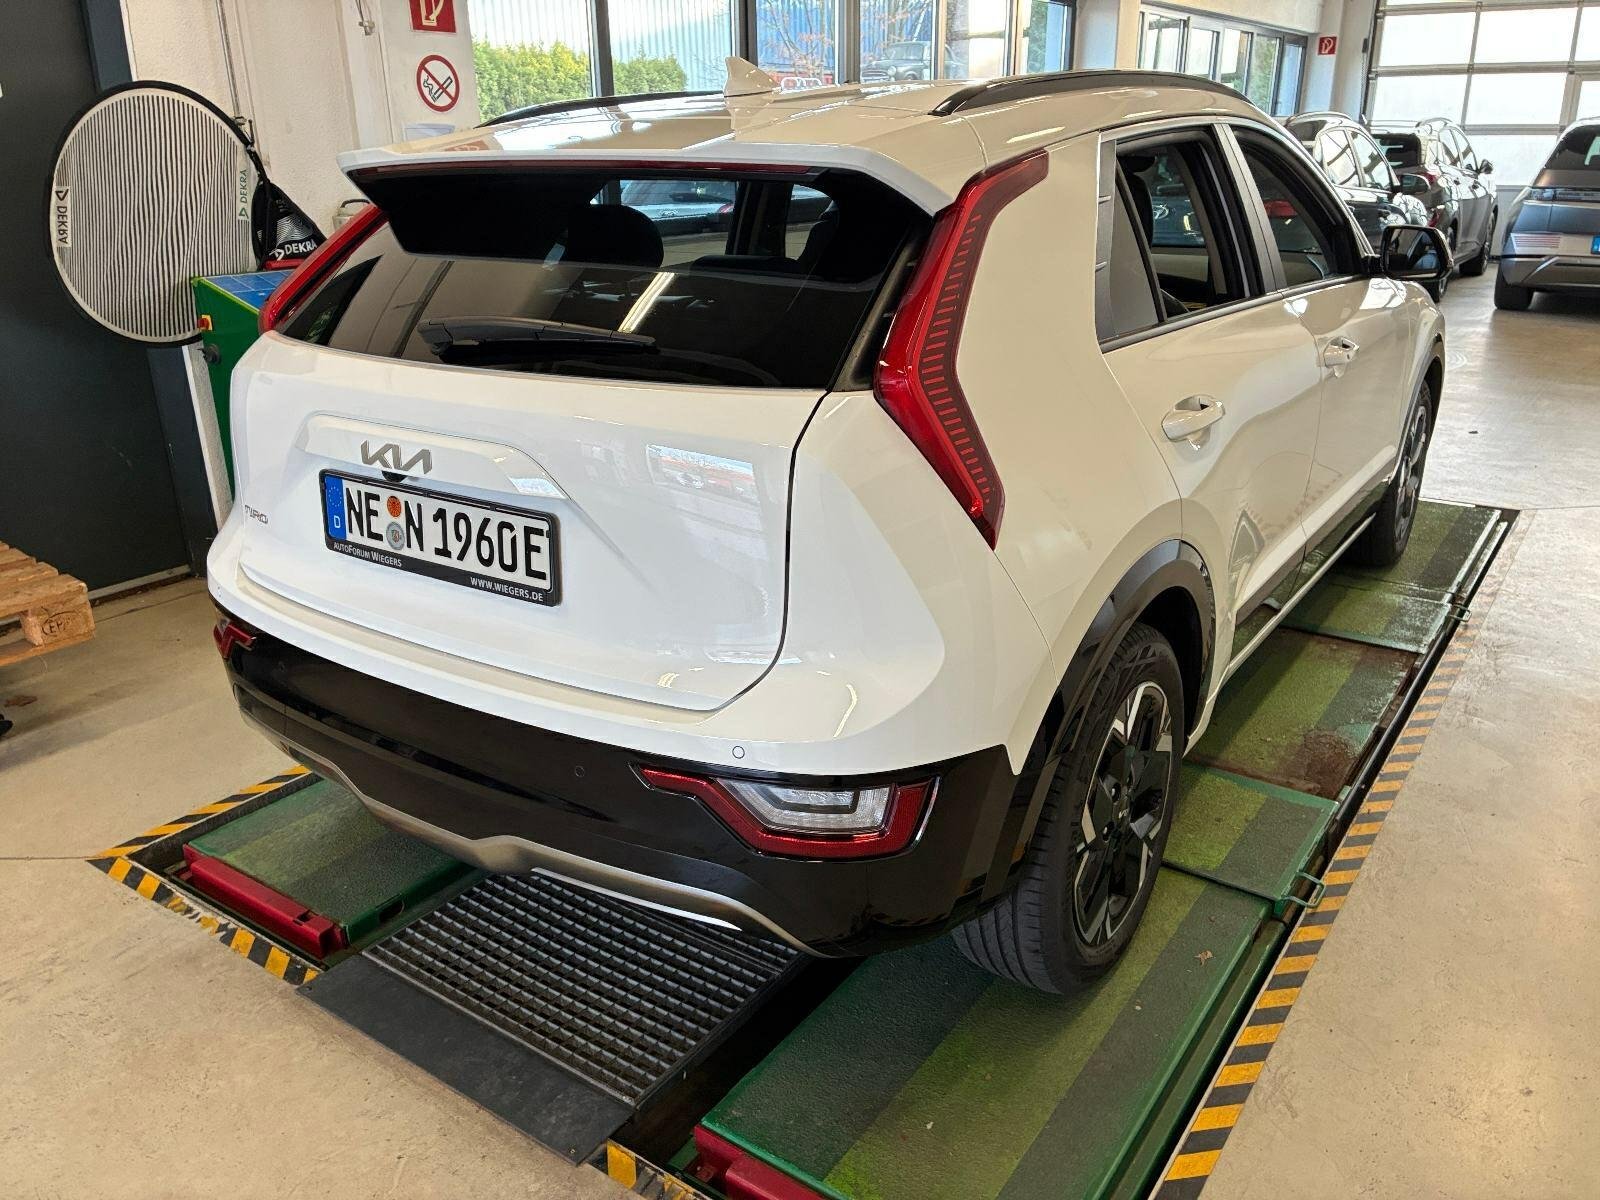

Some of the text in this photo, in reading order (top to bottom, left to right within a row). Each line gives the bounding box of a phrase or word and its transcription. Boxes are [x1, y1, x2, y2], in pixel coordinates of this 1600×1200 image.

[239, 169, 248, 204] DEKRA
[284, 239, 318, 255] DEKRA
[360, 440, 433, 475] KIA
[333, 514, 342, 529] D
[345, 487, 547, 581] NE N 1960E
